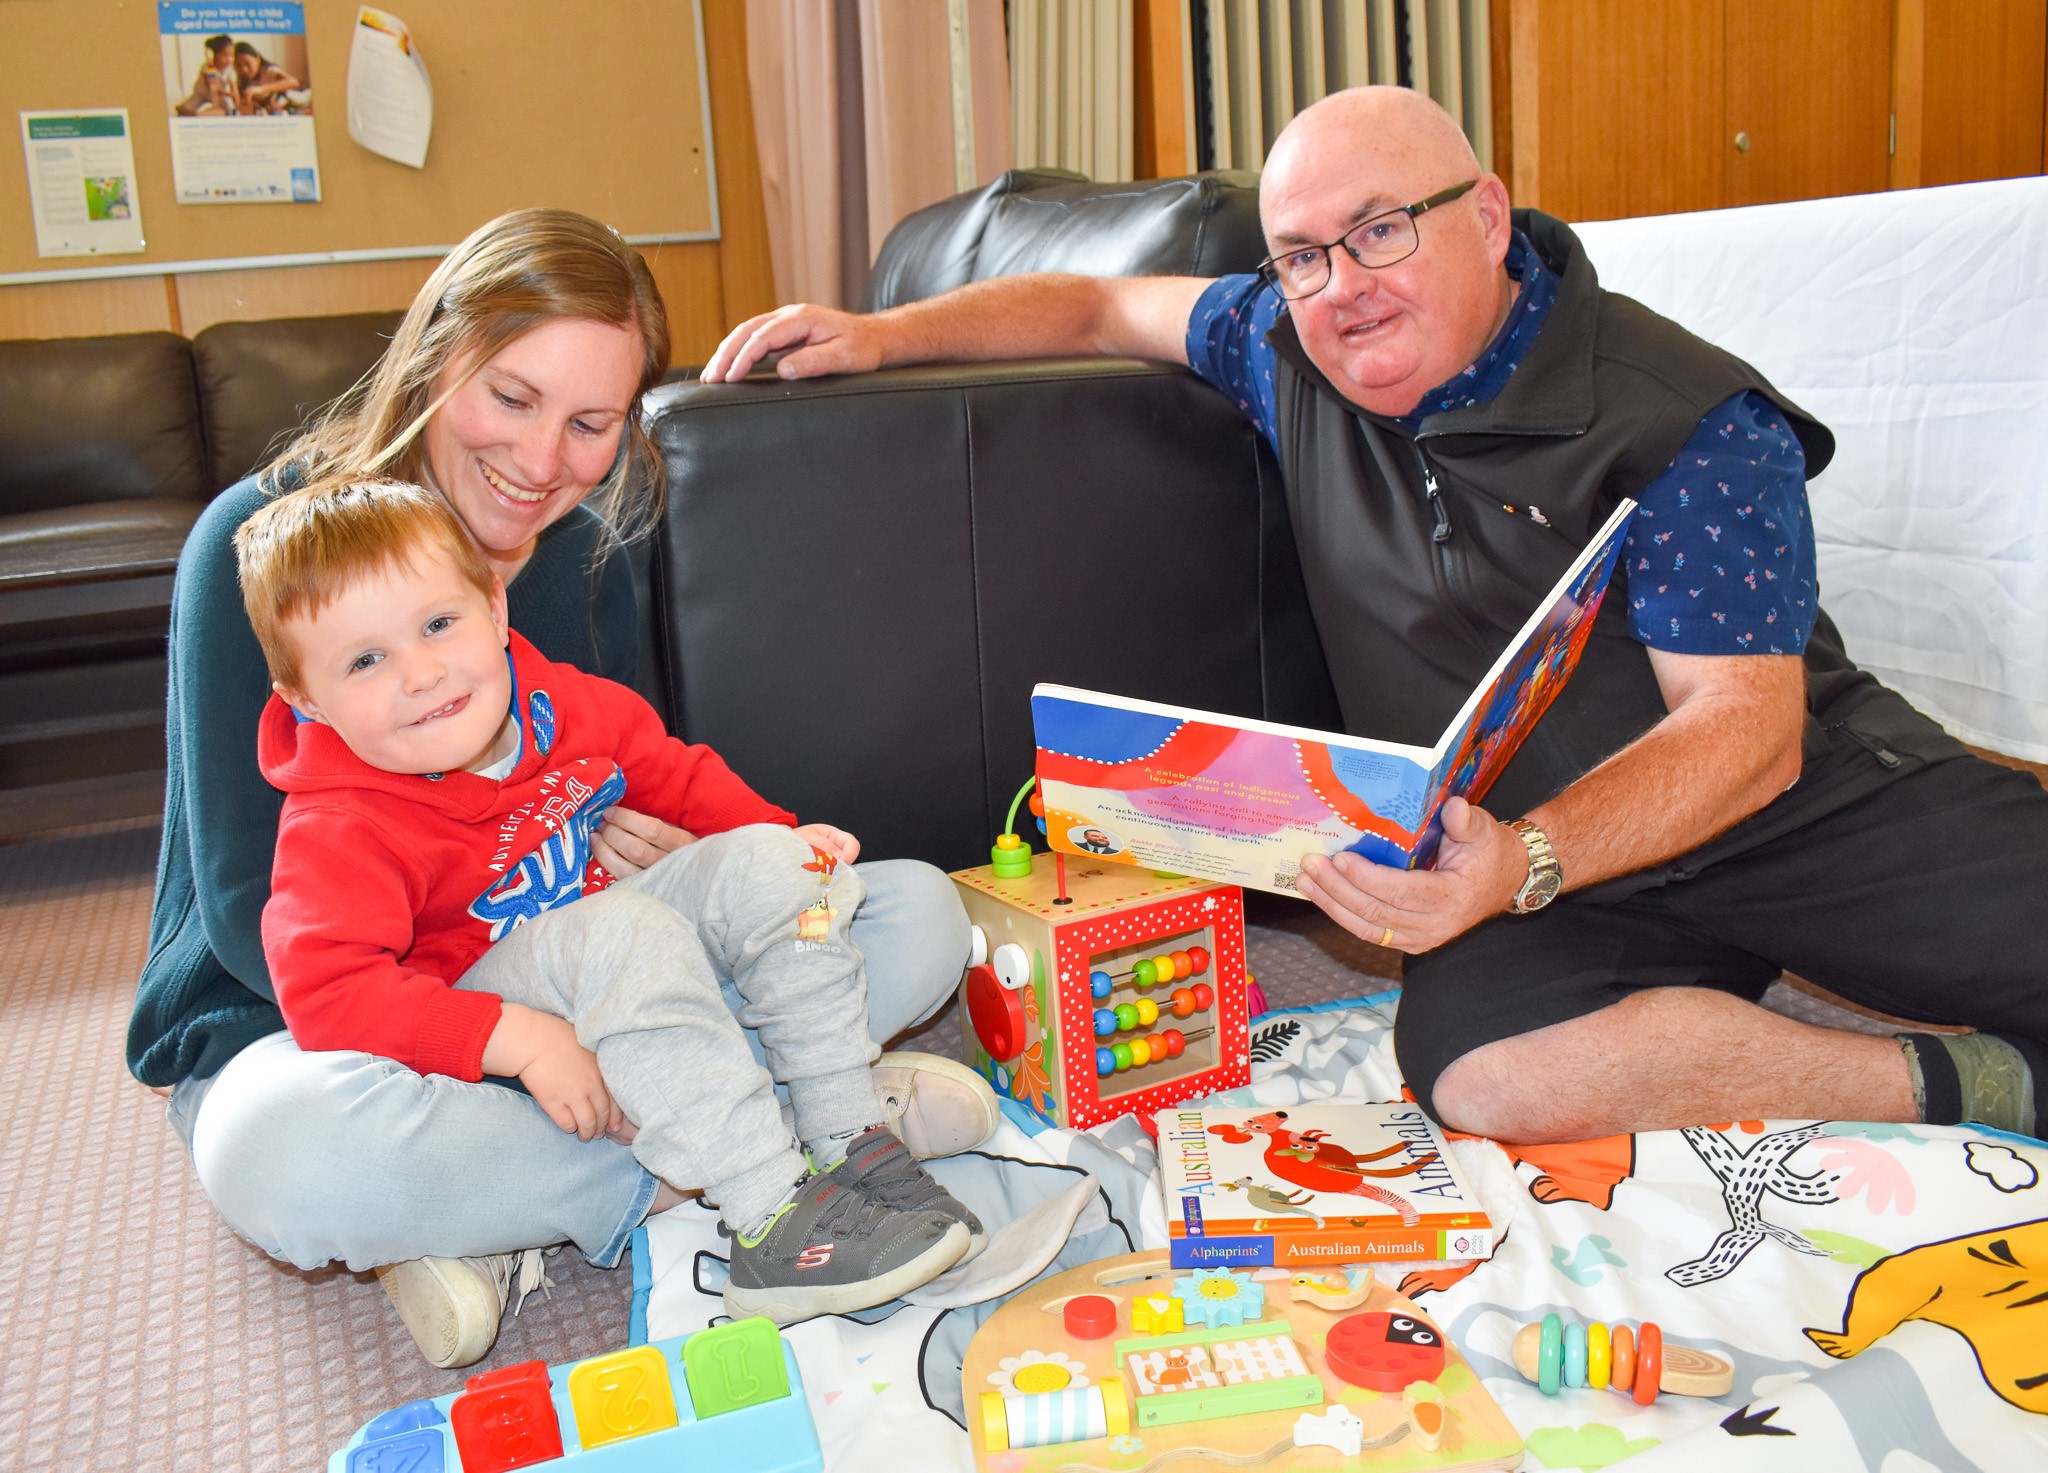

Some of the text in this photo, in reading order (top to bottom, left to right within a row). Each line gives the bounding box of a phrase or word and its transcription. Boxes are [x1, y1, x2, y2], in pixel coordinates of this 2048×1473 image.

[1149, 774, 1293, 807] legends past and present.
[1156, 769, 1220, 786] celebration
[1238, 783, 1300, 800] Indigenous
[1115, 807, 1211, 830] acknowledgement
[1215, 825, 1227, 833] of
[1229, 828, 1247, 836] the
[1250, 833, 1283, 843] oldest
[1147, 799, 1211, 815] generations
[1214, 808, 1254, 823] forging
[1257, 816, 1284, 827] their
[1313, 830, 1343, 839] path.
[1183, 798, 1225, 811] rallying
[1229, 805, 1248, 815] call
[1252, 808, 1263, 817] to
[1267, 813, 1318, 828] emerging
[1115, 815, 1172, 829] continuous
[1175, 825, 1212, 836] culture
[1231, 836, 1264, 847] earth.
[795, 941, 841, 954] BINGO
[1168, 1112, 1216, 1197] Australian
[1379, 1112, 1464, 1200] Animals
[1287, 1240, 1425, 1257] Australian Animals
